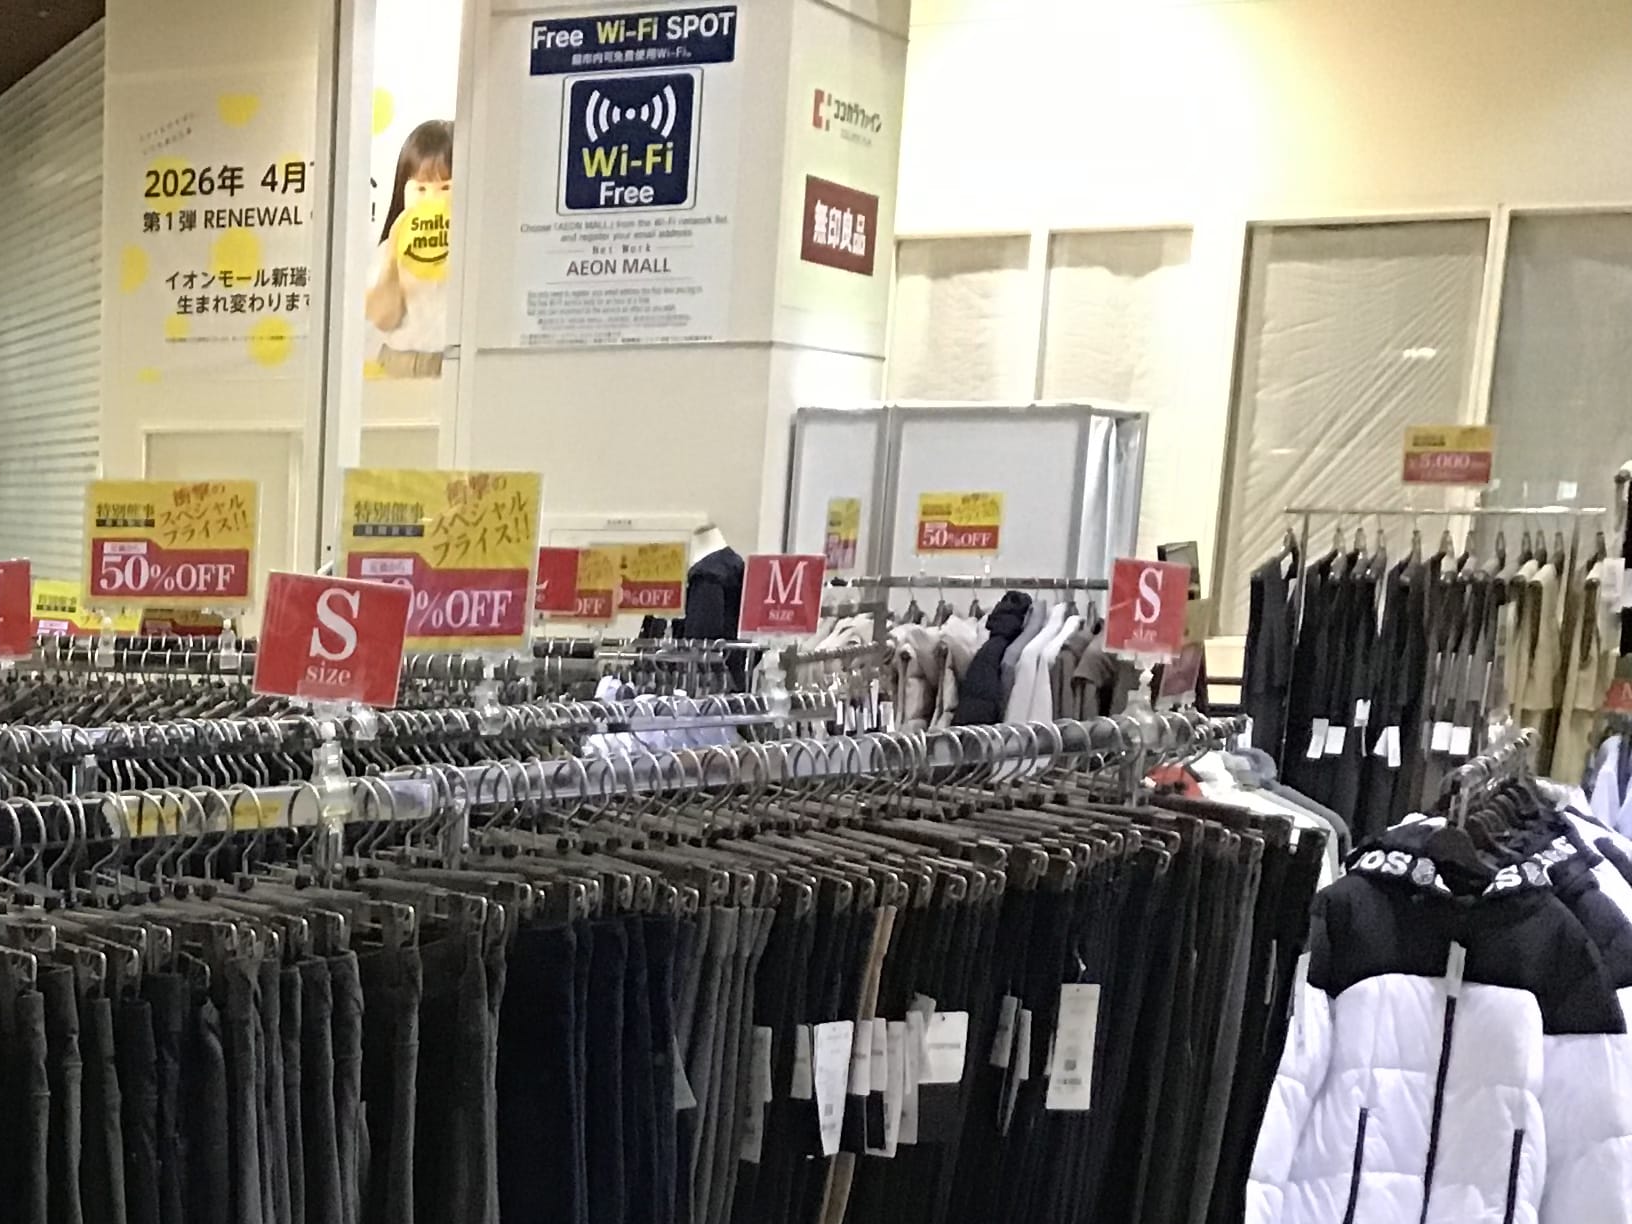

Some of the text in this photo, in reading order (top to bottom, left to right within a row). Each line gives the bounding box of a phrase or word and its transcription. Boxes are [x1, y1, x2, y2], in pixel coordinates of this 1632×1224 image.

[533, 12, 735, 49] Free Wi-Fi SPOT
[582, 141, 674, 178] Wi-Fi
[144, 161, 315, 198] 2026年 4月
[599, 181, 654, 205] Free
[143, 206, 303, 233] 第1弾 RENEWAL
[813, 199, 866, 256] 無印良品
[165, 267, 311, 290] イオンモール新瑞
[567, 257, 672, 276] AEON MALL
[922, 527, 992, 547] 50%OFF
[100, 555, 235, 591] 50%OFF
[764, 559, 808, 605] M
[769, 605, 794, 620] size
[1134, 567, 1164, 623] S
[309, 588, 361, 661] S
[305, 661, 352, 685] size
